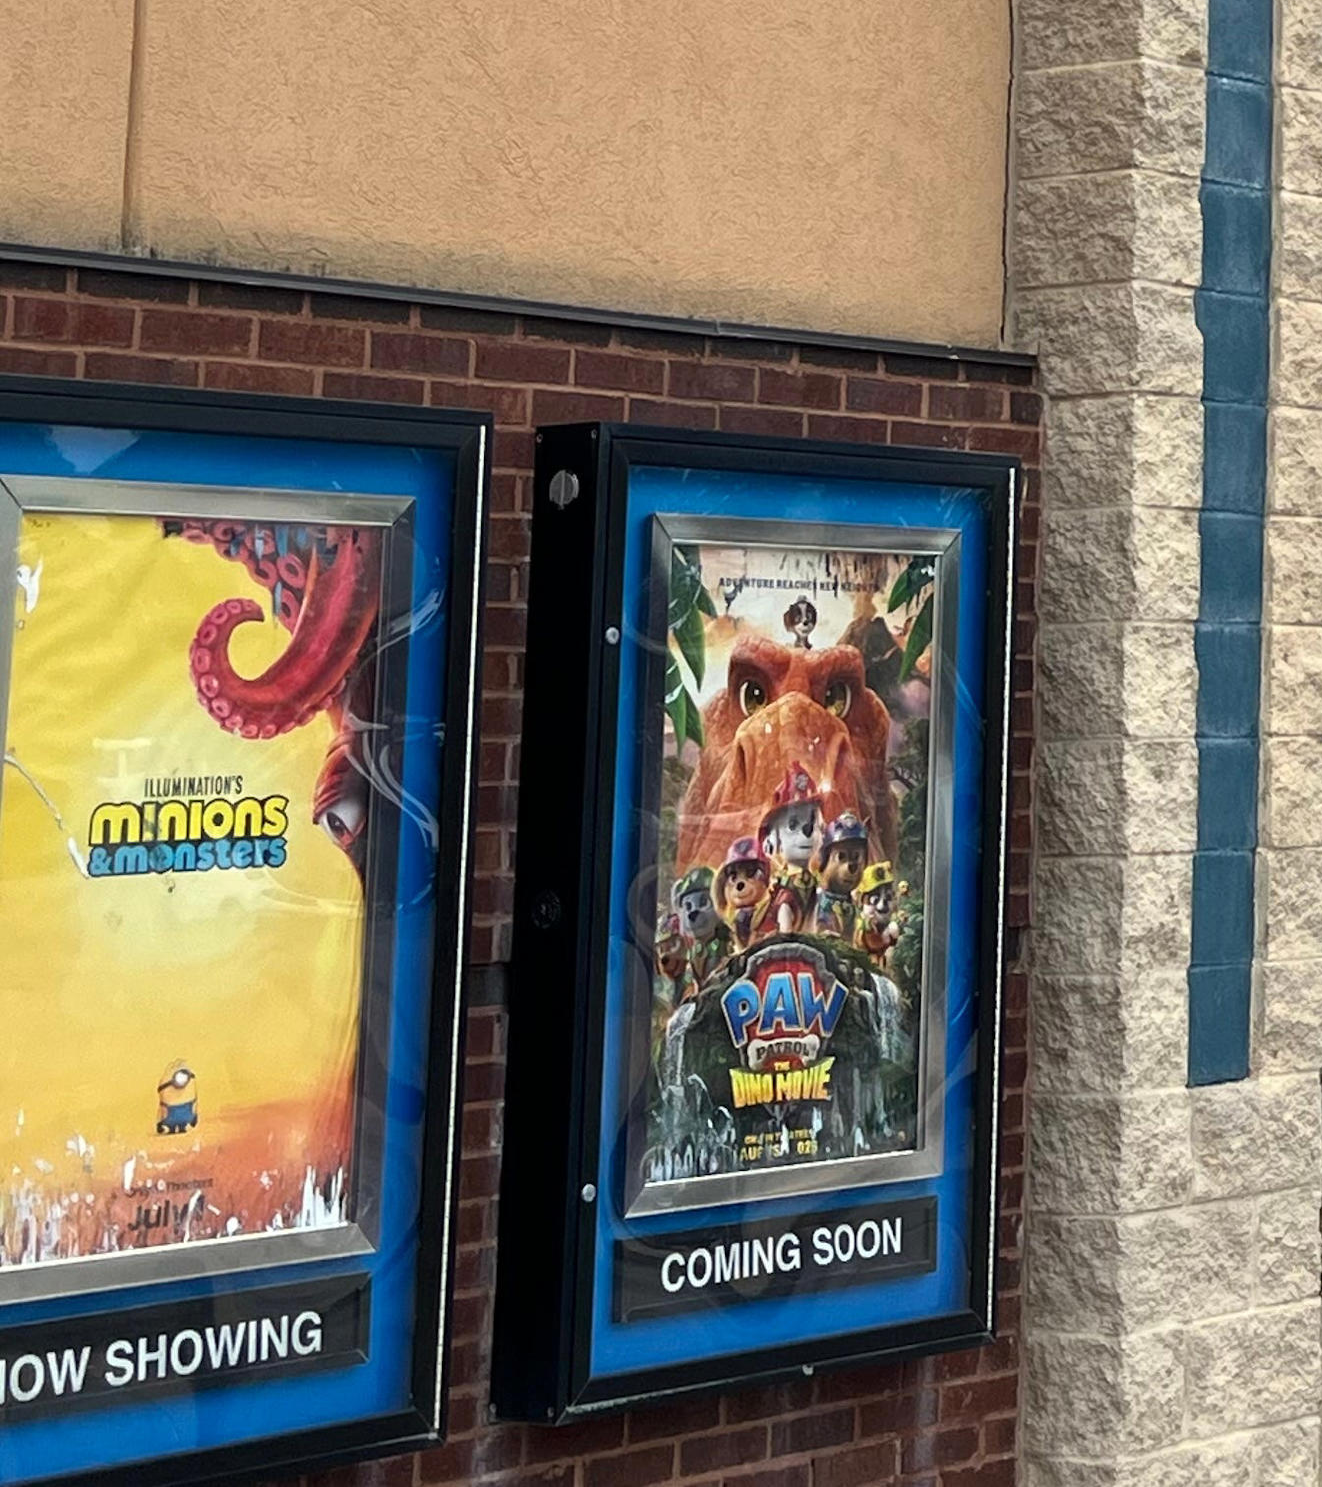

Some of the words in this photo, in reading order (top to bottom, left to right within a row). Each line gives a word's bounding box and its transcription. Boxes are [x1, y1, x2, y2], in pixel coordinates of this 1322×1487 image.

[144, 775, 243, 798] ILLUMINATION'S
[721, 972, 849, 1049] PAW
[729, 1068, 774, 1109] DINO
[776, 1056, 837, 1102] MOVIE
[756, 1040, 810, 1061] PATROL
[661, 1232, 801, 1293] COMING
[812, 1217, 902, 1266] SOON
[0, 1345, 91, 1405] OW
[104, 1310, 322, 1388] SHOWING
